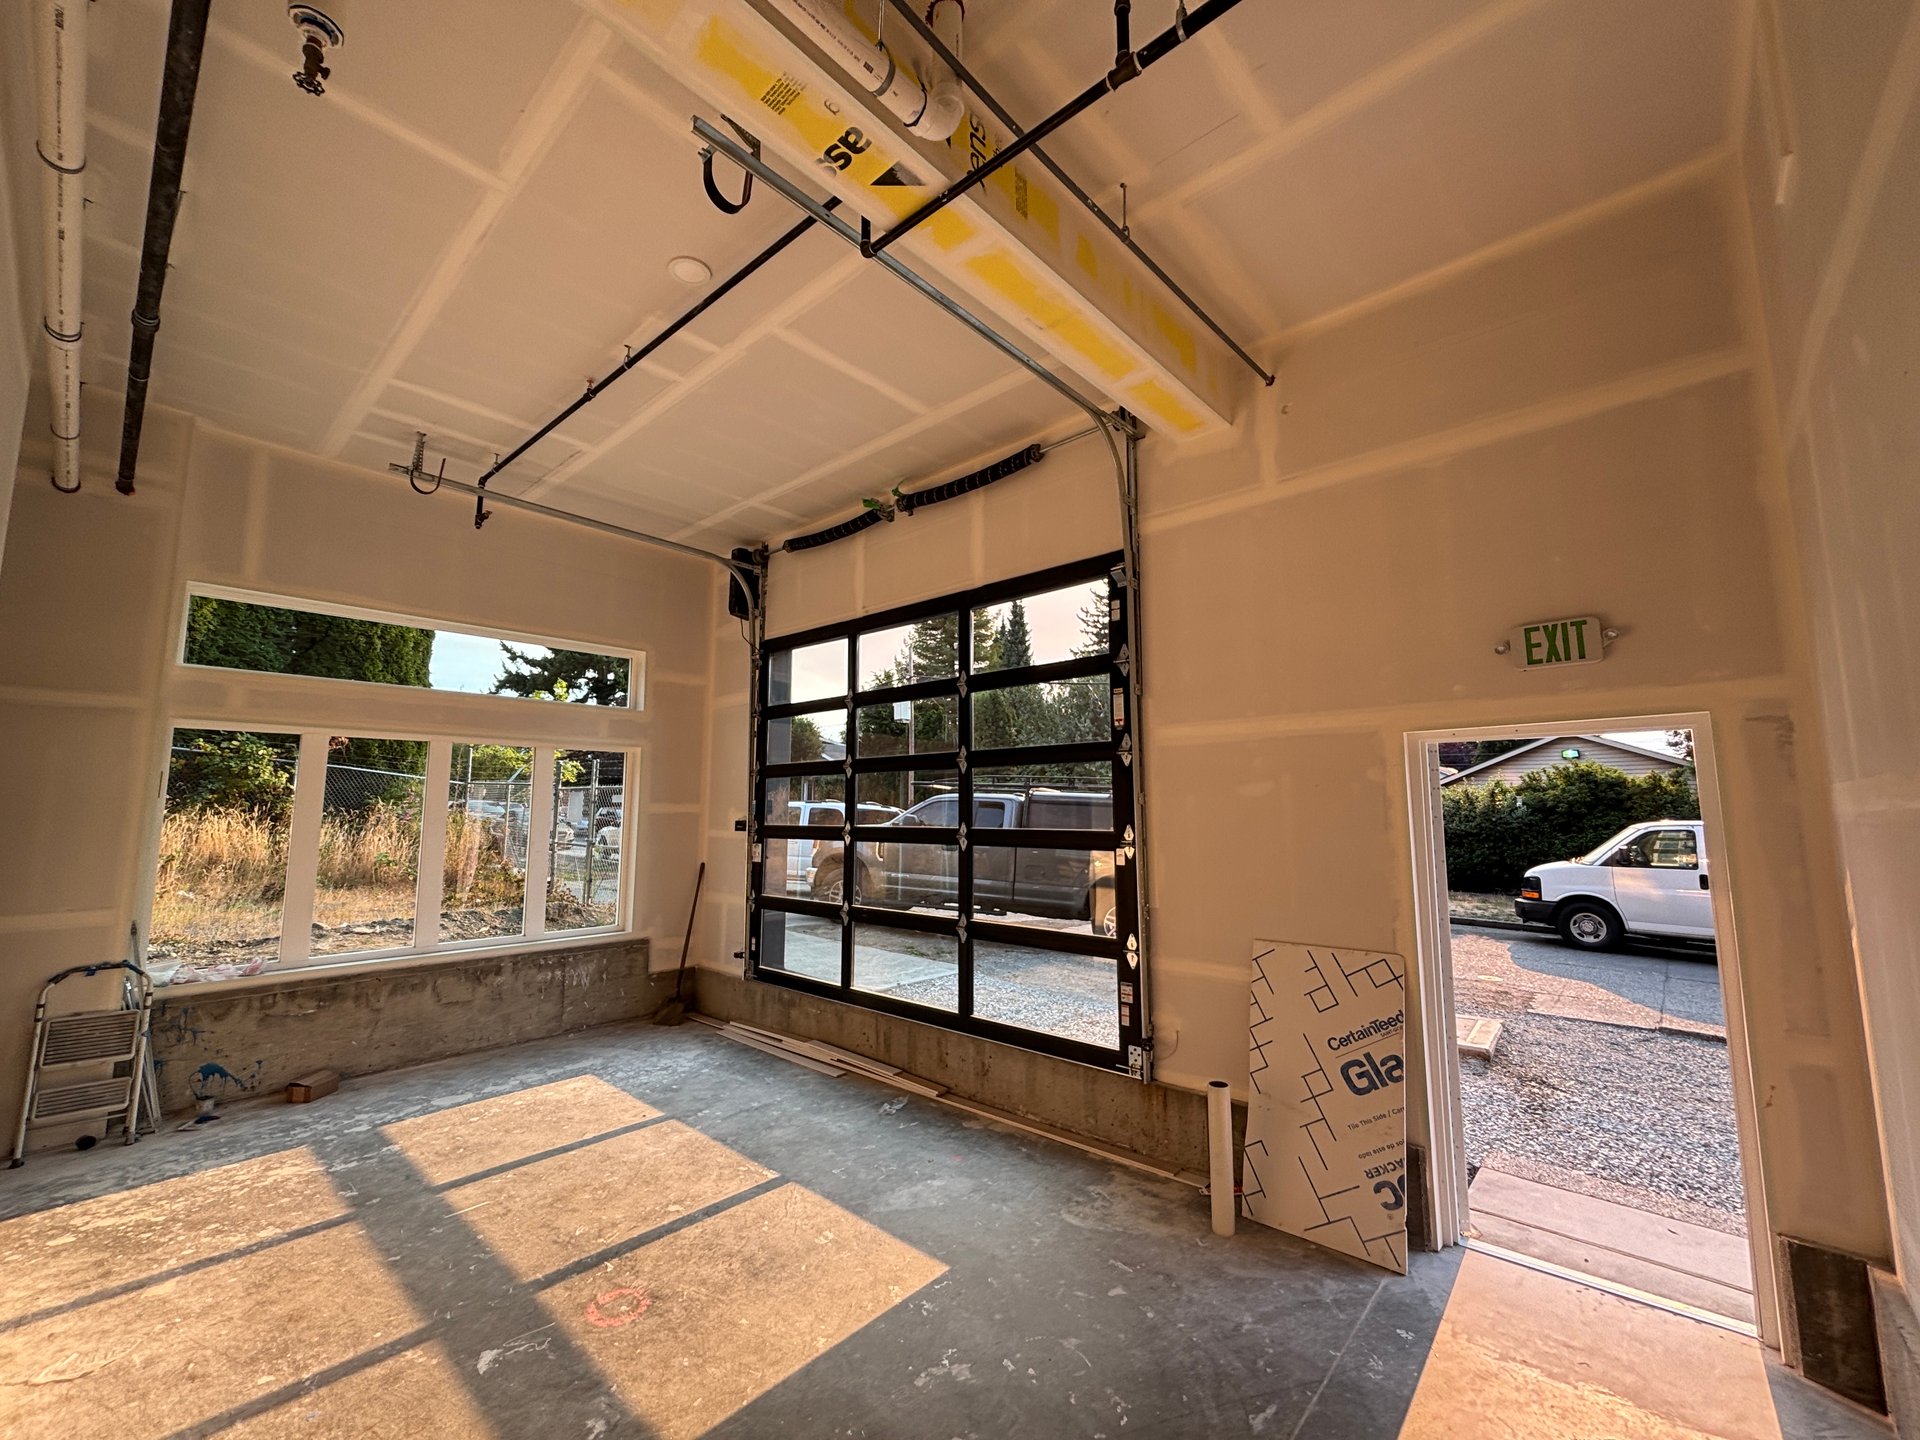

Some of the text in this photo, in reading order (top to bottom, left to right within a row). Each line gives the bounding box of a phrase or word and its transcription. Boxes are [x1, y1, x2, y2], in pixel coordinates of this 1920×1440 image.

[1524, 620, 1587, 665] EXIT
[1327, 1009, 1404, 1051] CertainTeed
[1364, 1157, 1404, 1179] ACKER
